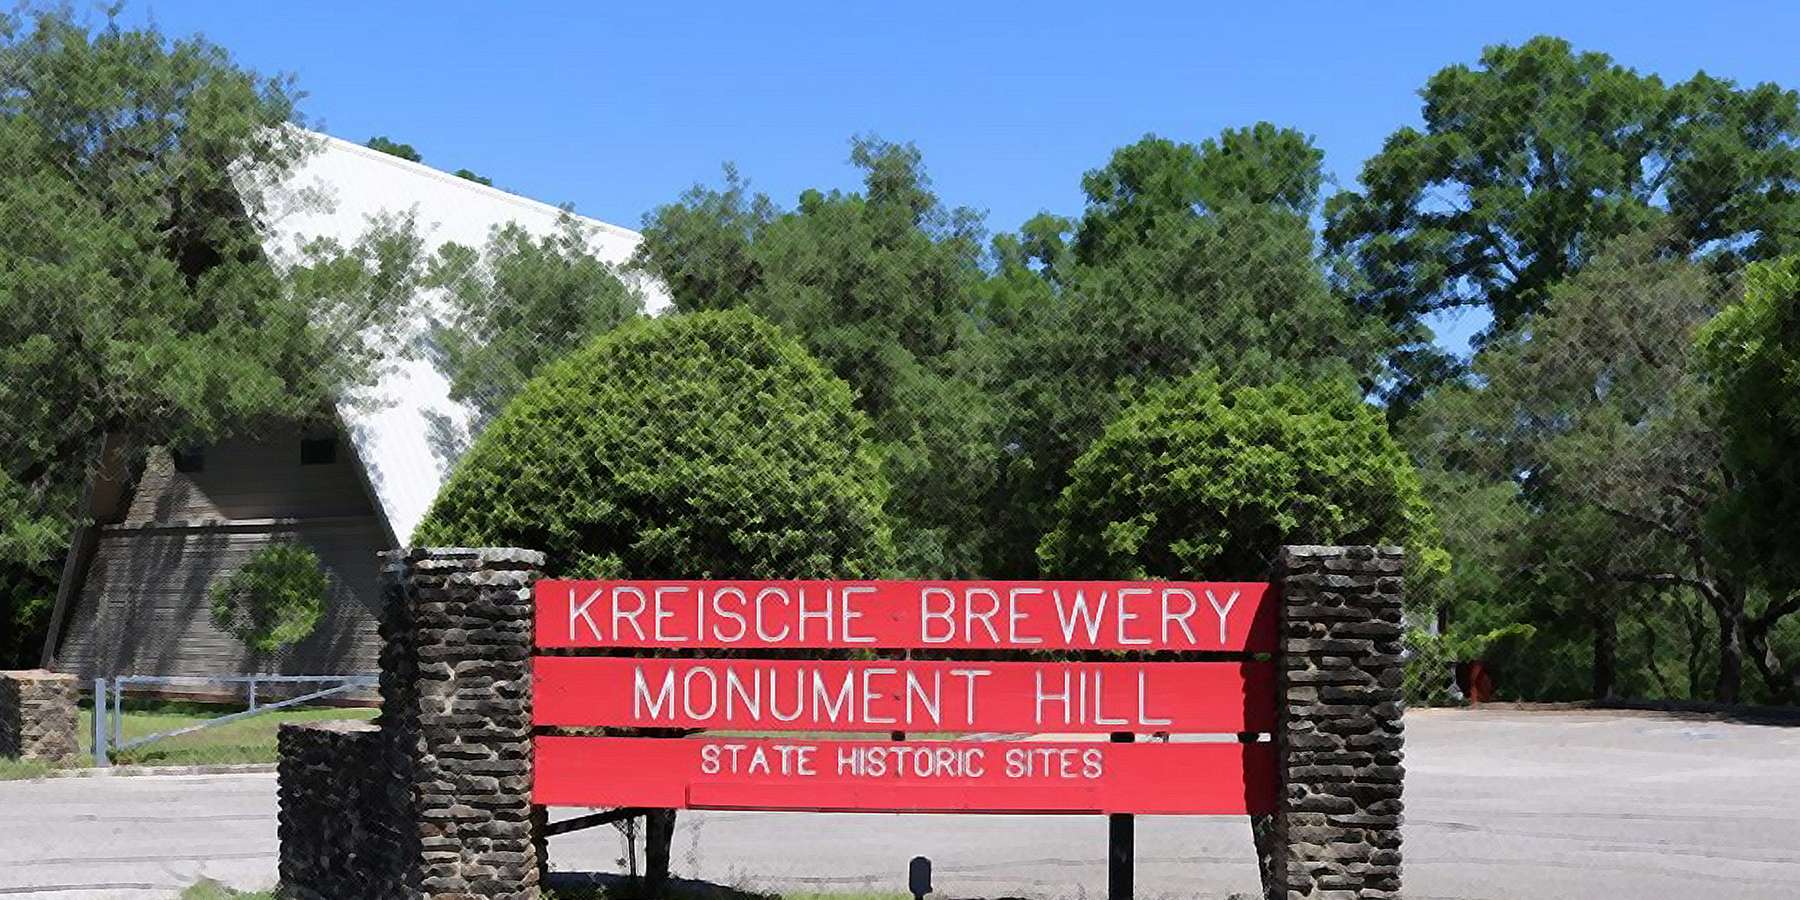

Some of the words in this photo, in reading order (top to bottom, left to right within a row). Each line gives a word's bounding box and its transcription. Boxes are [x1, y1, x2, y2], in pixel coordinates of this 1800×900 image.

[568, 586, 877, 643] KREISCHE
[921, 587, 1241, 645] BREWERY
[633, 667, 992, 726] MONUMENT
[1035, 670, 1173, 726] HILL
[700, 745, 817, 776] STATE
[837, 747, 985, 778] HISTORIC
[1005, 748, 1104, 780] SITES
